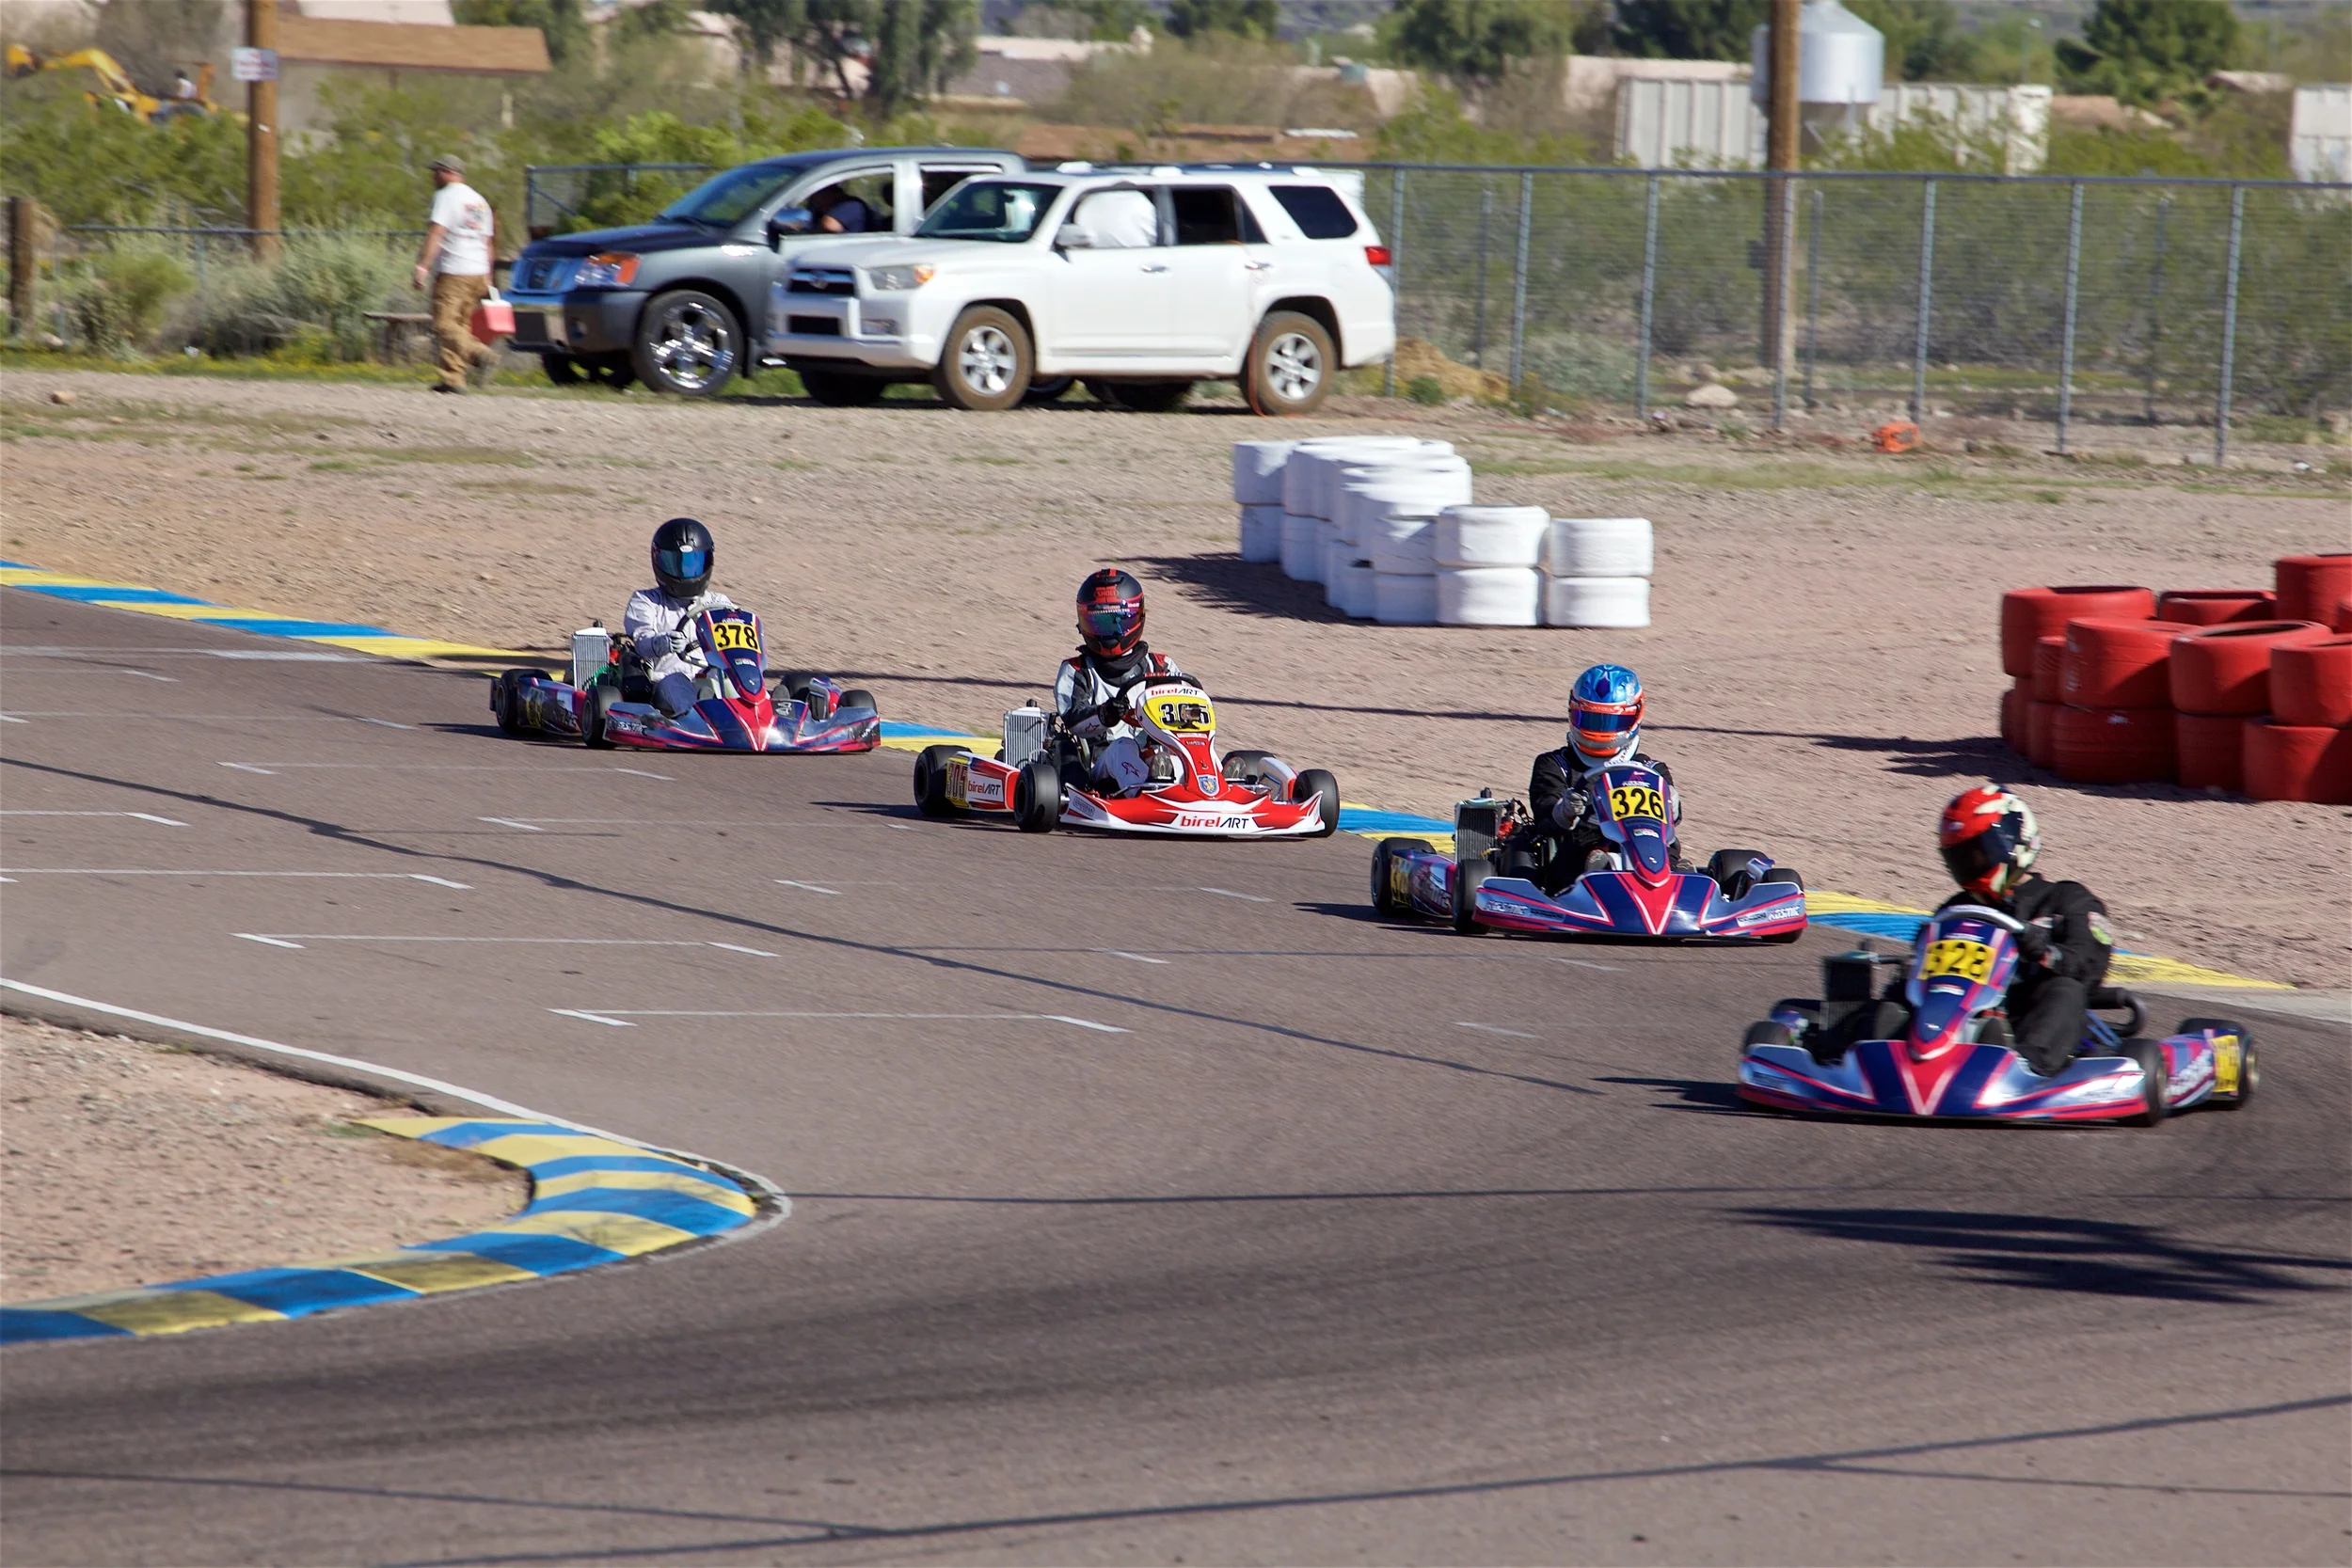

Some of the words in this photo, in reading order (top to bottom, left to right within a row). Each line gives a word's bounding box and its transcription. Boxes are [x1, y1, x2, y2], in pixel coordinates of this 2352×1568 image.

[714, 624, 758, 650] 378
[1612, 787, 1664, 820] 326
[1180, 816, 1249, 829] birelART
